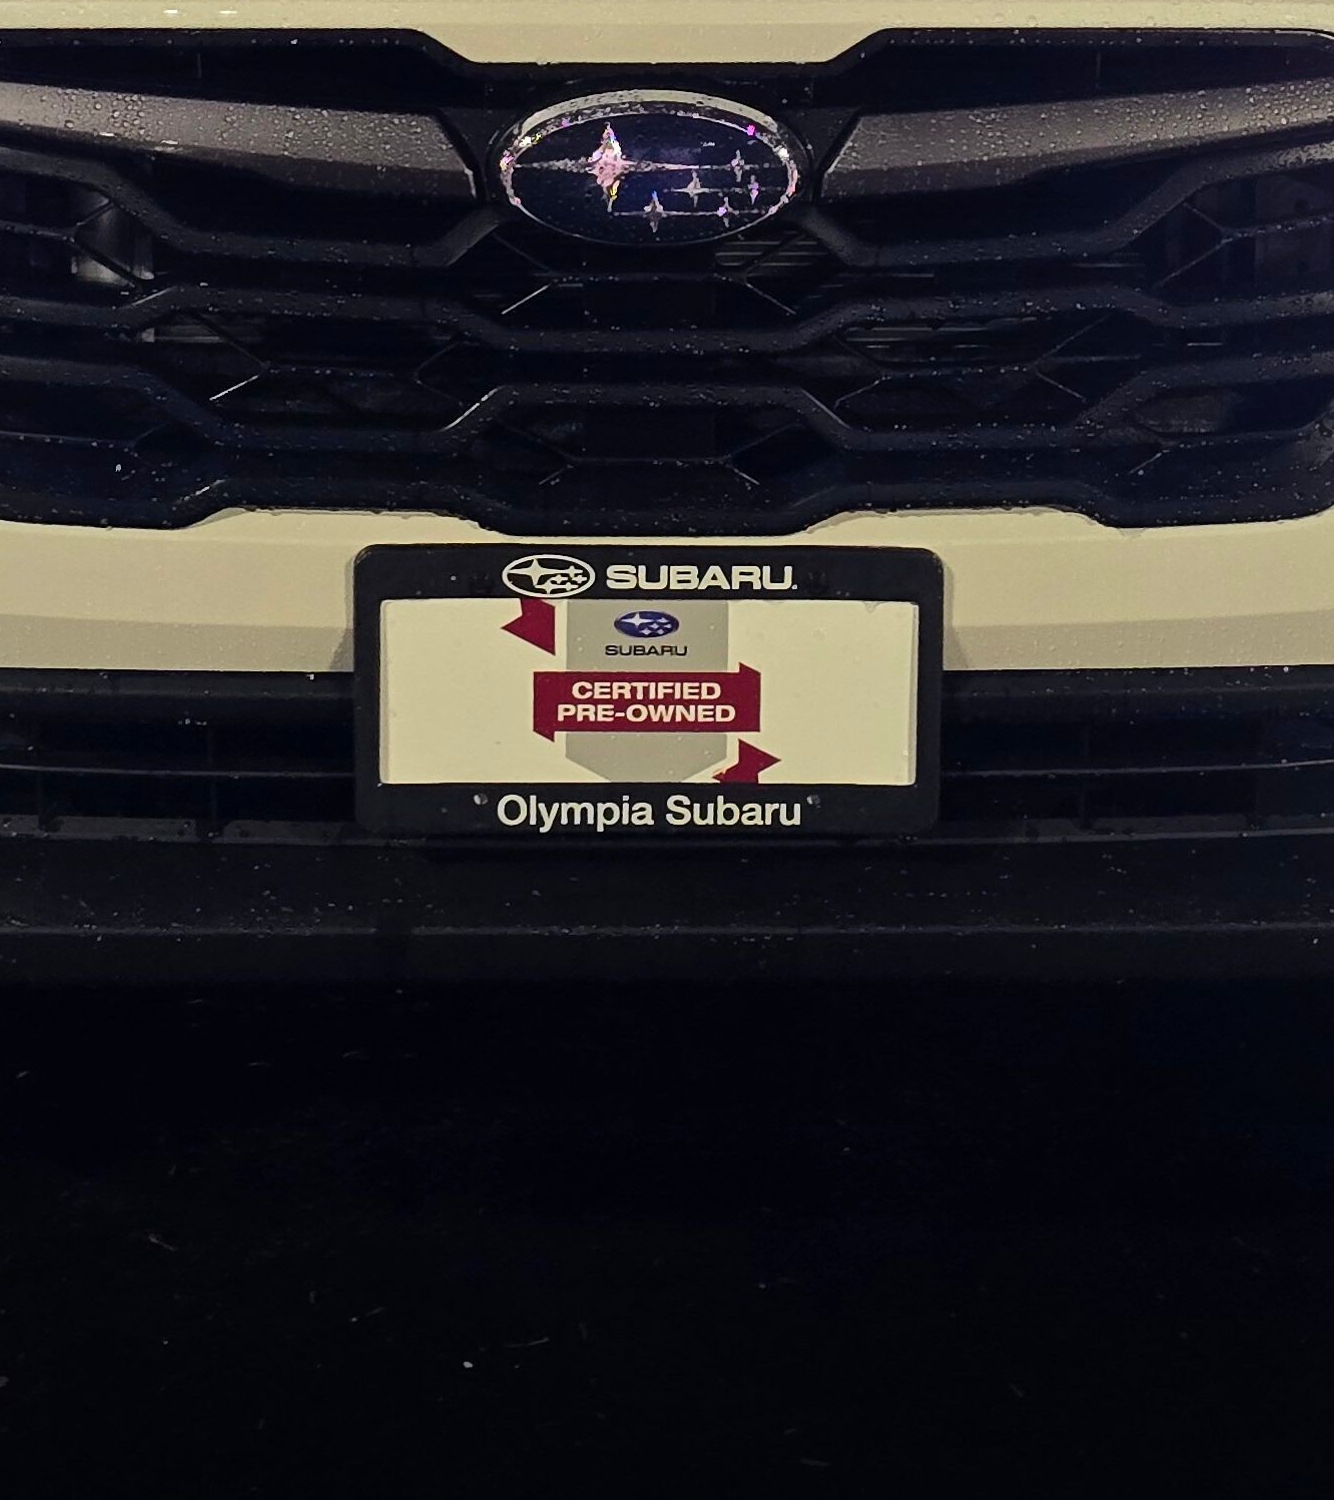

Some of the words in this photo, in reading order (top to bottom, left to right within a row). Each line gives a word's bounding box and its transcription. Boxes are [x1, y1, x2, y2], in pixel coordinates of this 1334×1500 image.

[604, 644, 688, 657] SUBARU
[571, 681, 722, 700] CERTIFIED
[557, 703, 737, 723] PRE-OWNED
[497, 794, 655, 833] Olympia
[665, 794, 801, 826] Subaru
